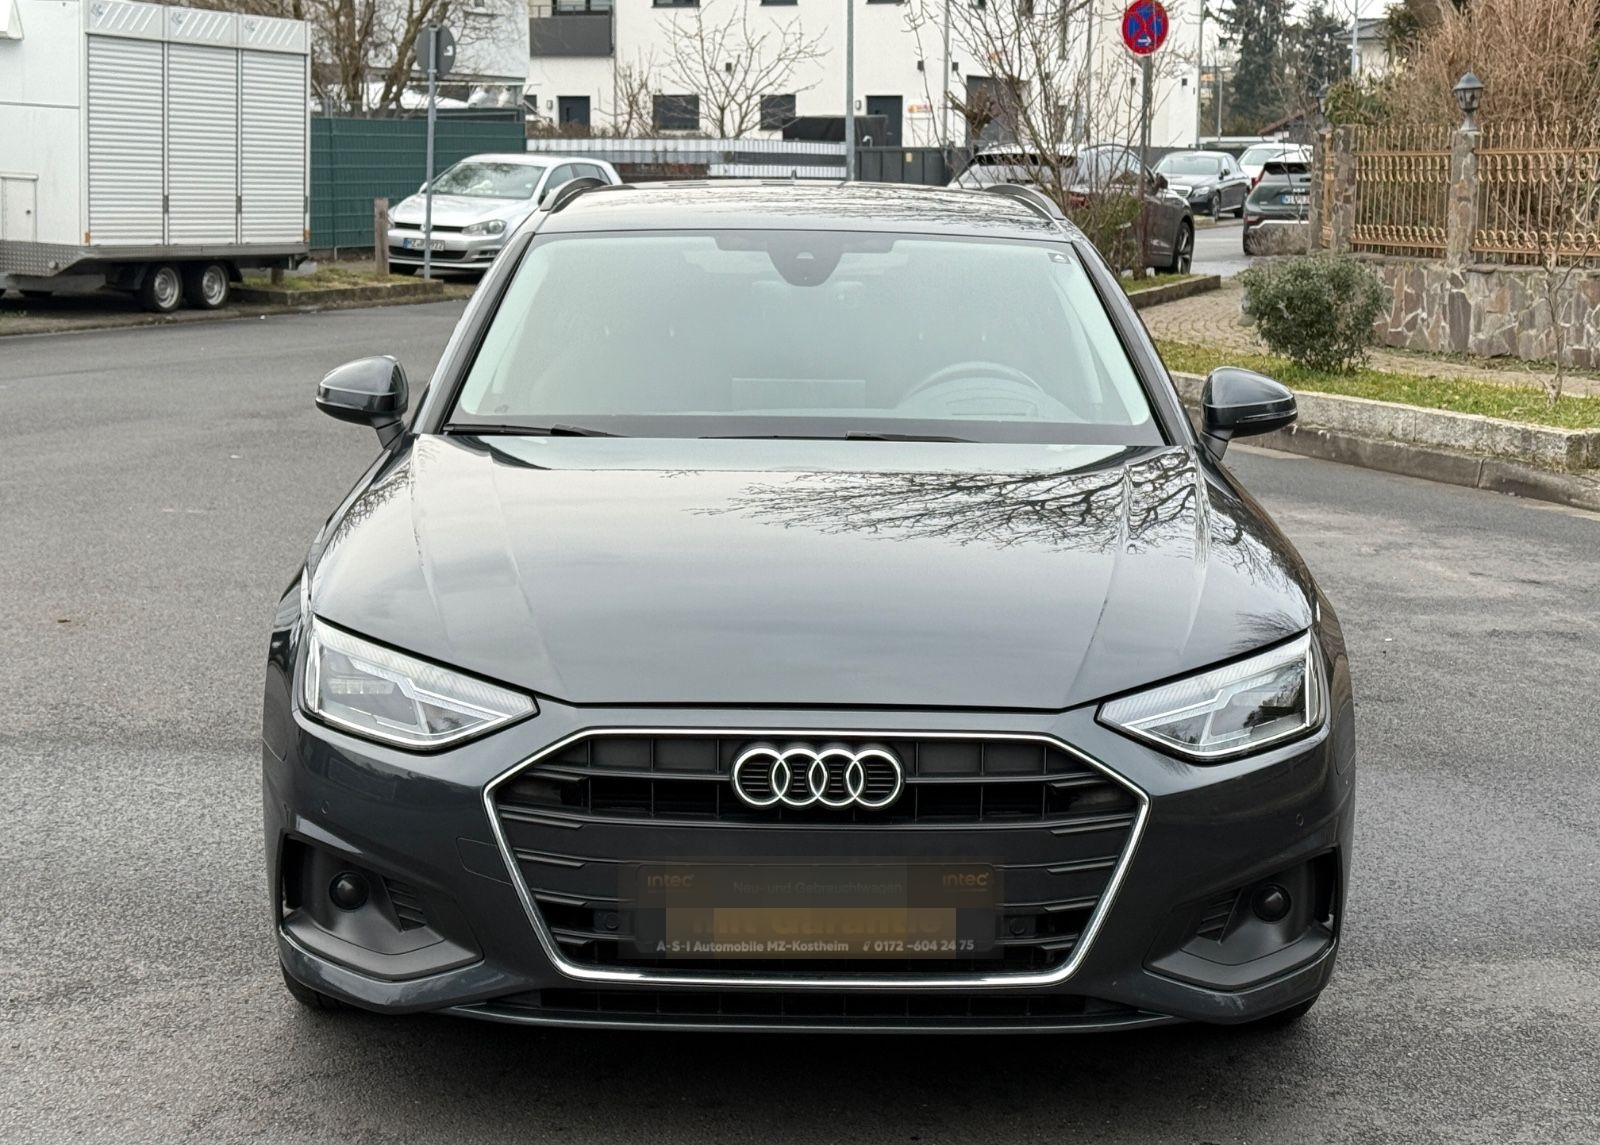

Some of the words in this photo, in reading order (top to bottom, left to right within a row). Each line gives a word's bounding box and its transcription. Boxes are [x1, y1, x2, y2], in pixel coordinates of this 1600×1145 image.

[647, 874, 694, 887] intec
[942, 872, 990, 886] intec
[733, 882, 763, 894] Neu-
[767, 882, 791, 894] und
[795, 882, 902, 896] Gebrauchtwagen
[693, 940, 764, 952] Automobile
[767, 940, 849, 952] MZ-Kostheim
[874, 940, 904, 952] 0172
[940, 940, 956, 952] 24
[958, 939, 975, 951] 75
